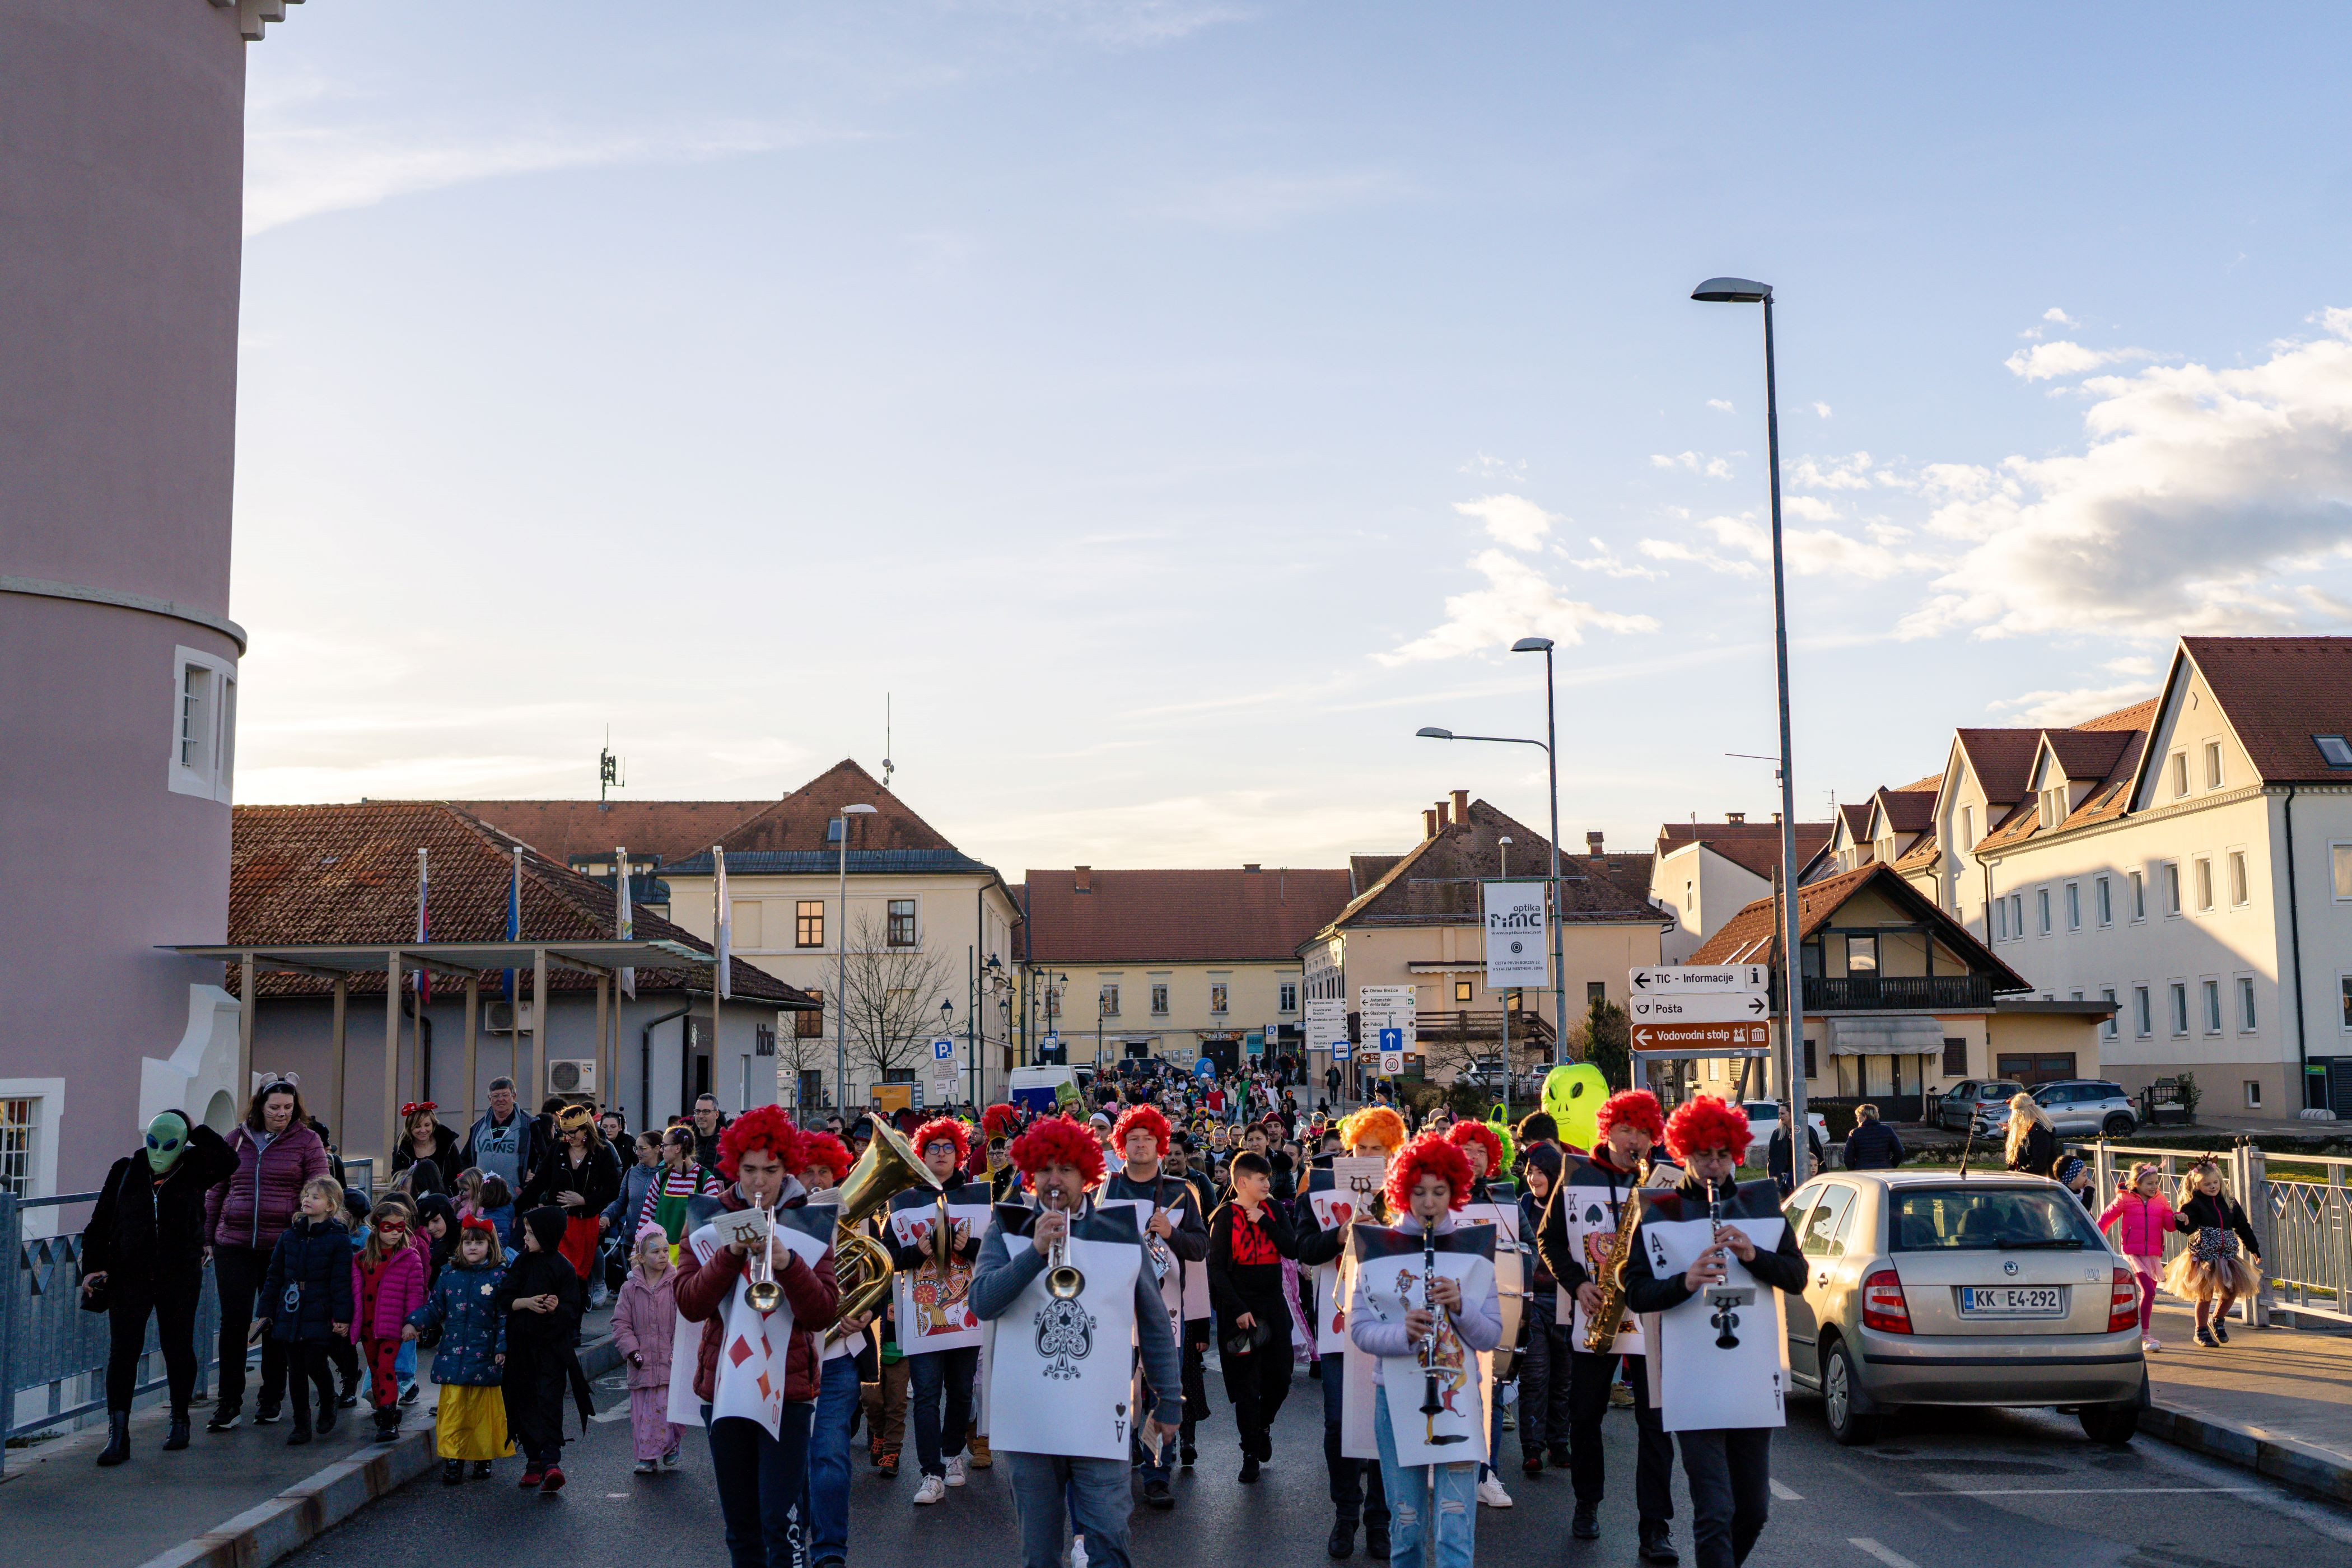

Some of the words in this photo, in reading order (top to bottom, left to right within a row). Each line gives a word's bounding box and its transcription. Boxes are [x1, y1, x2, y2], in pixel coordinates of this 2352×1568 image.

[1513, 904, 1541, 913] optika
[1655, 974, 1670, 983] TIC
[1683, 973, 1734, 984] Informacije
[1656, 1004, 1683, 1014] Pošta
[1656, 1031, 1704, 1041] Vodovodni
[1706, 1030, 1730, 1042] stolp
[939, 1044, 949, 1057] P
[477, 1138, 515, 1154] VANS
[1314, 1198, 1324, 1215] 7
[1568, 1193, 1577, 1210] K
[897, 1217, 904, 1233] J
[1652, 1232, 1664, 1253] A
[1975, 1290, 1996, 1306] KK
[2007, 1290, 2057, 1307] E4-292
[1114, 1420, 1126, 1443] A
